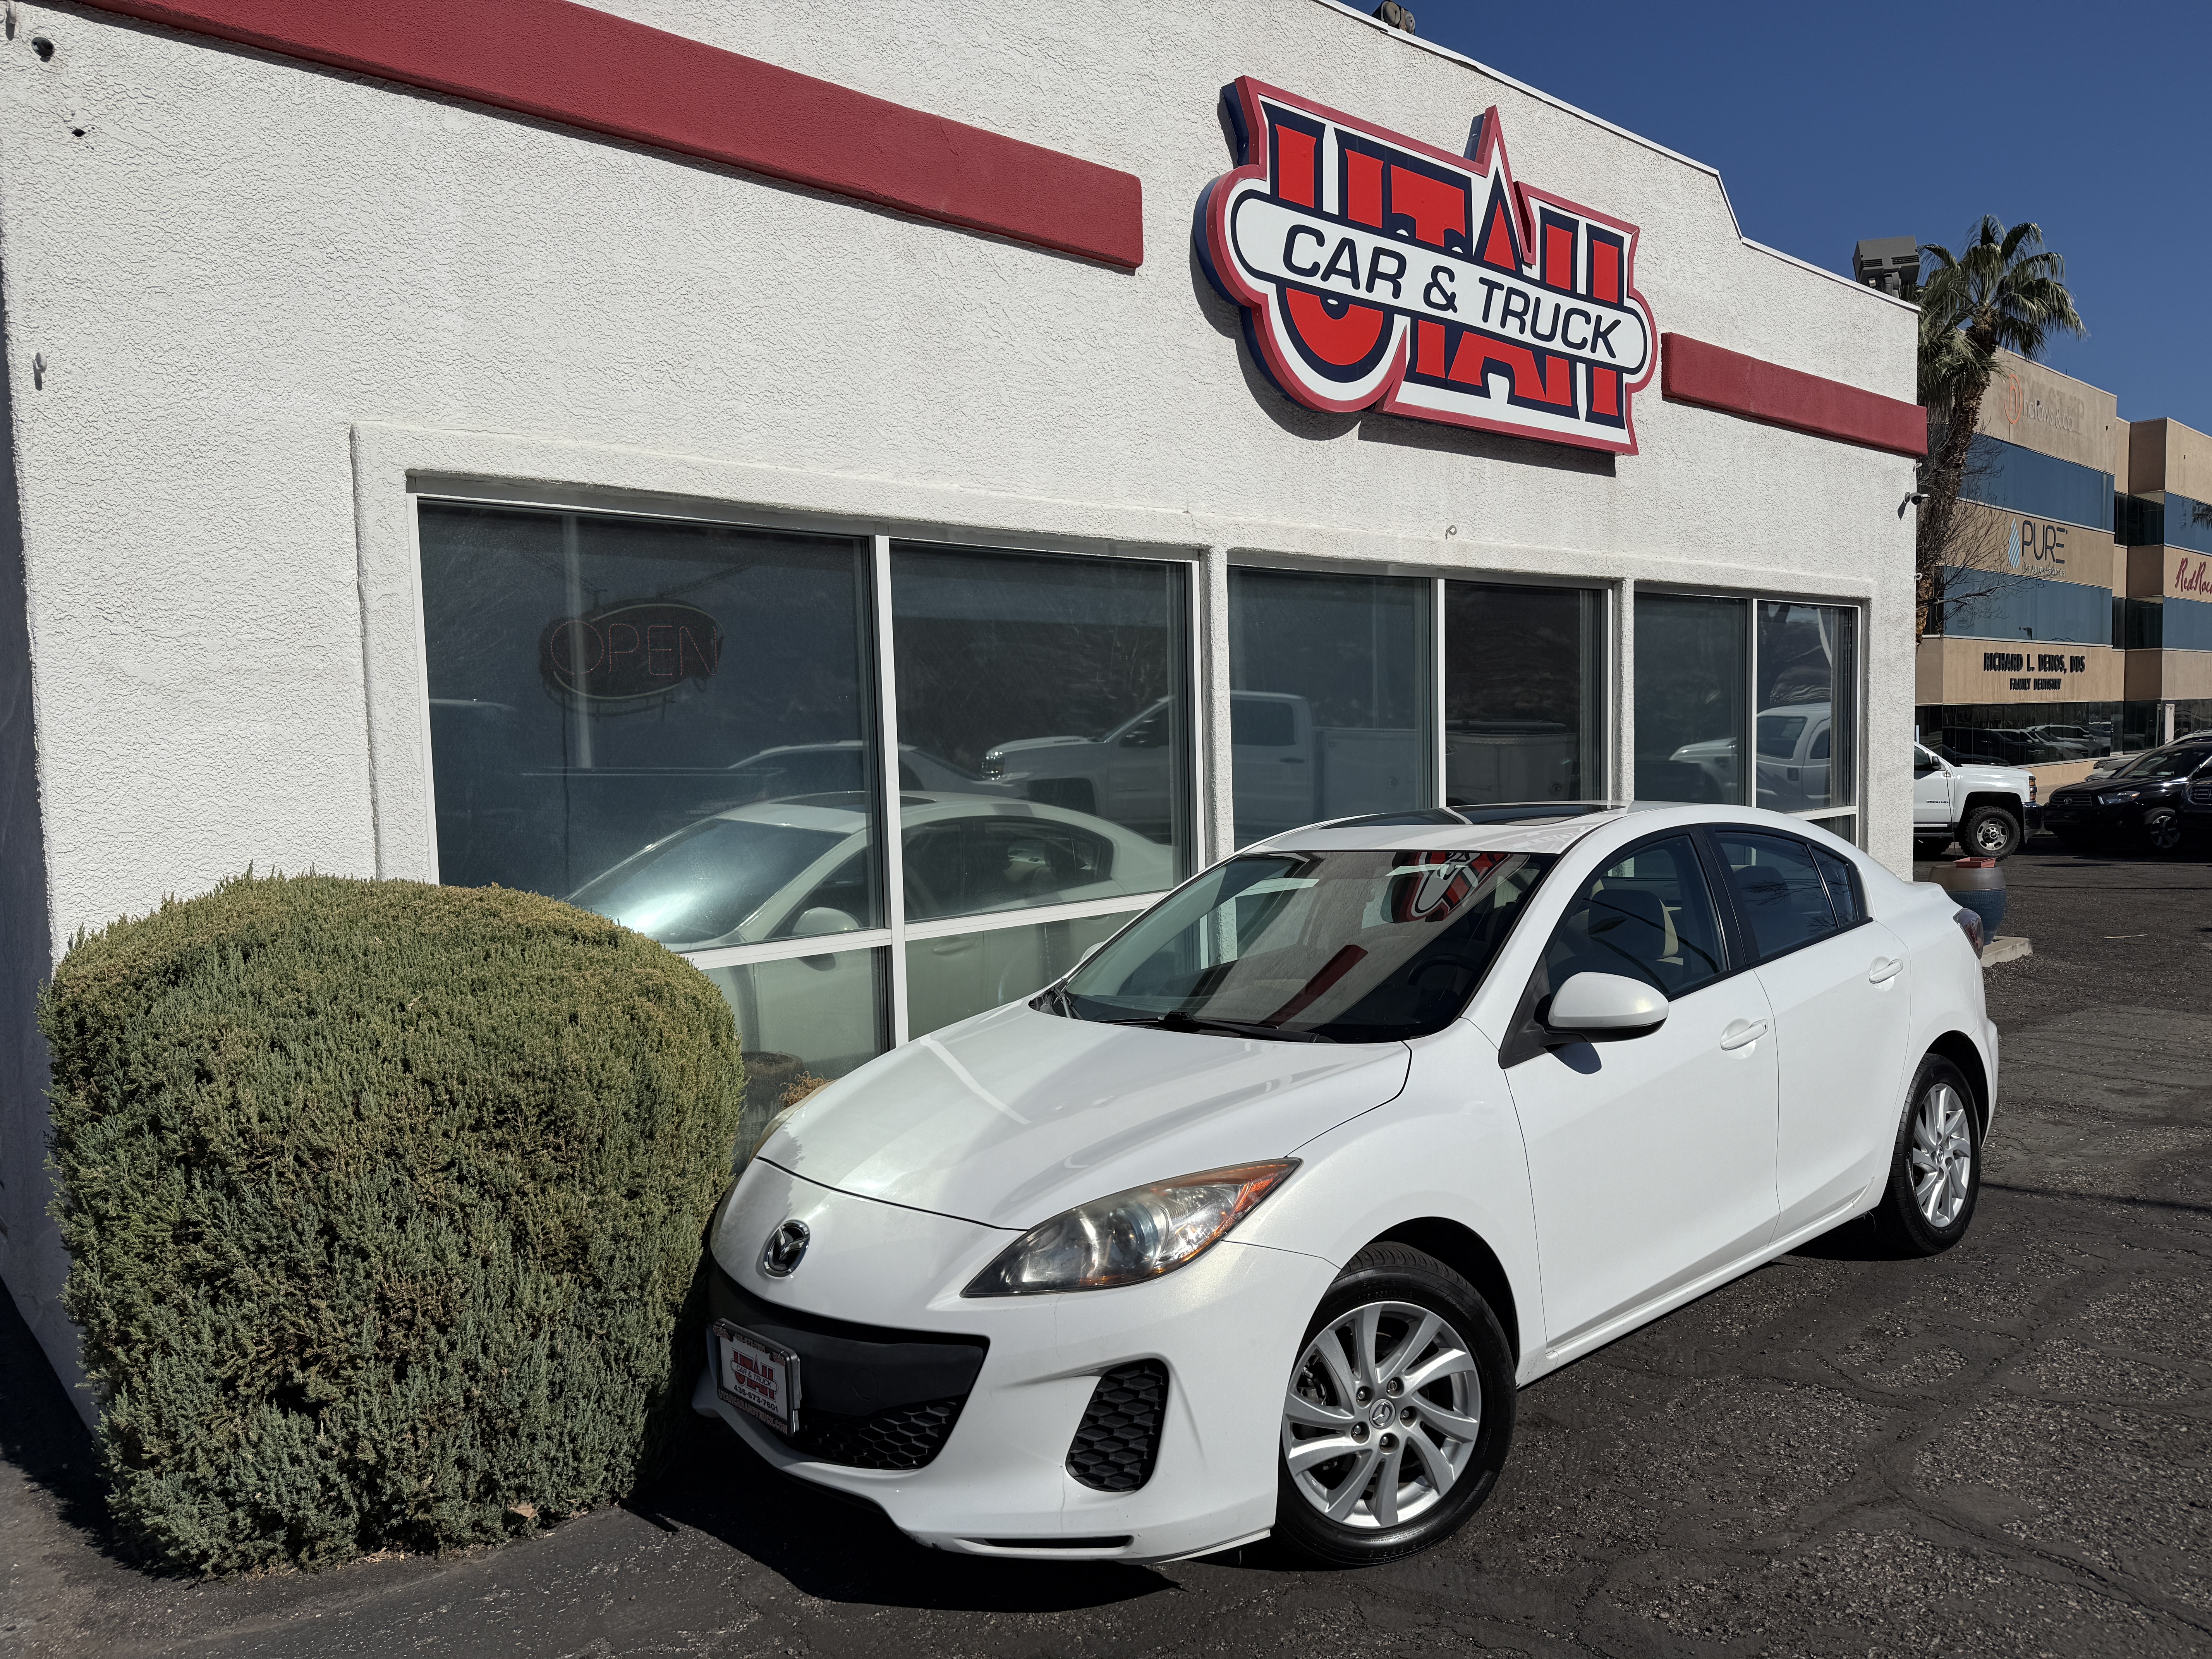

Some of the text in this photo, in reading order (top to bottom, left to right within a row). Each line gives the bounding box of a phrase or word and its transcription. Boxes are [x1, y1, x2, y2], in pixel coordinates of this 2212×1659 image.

[1261, 100, 1626, 430] UTAH
[1283, 224, 1622, 359] CAR & TRUCK
[2023, 395, 2054, 425] hallows
[2055, 409, 2061, 429] &
[2063, 414, 2073, 432] co
[2022, 520, 2066, 564] PURE
[2175, 557, 2212, 595] RedRoc
[551, 621, 717, 675] OPEN
[1984, 653, 2085, 674] RICHARD L. DENOS, DDS
[2010, 678, 2062, 690] FAMILY DENTISTRY
[732, 1348, 776, 1402] UTAH
[737, 1365, 747, 1375] CAR
[754, 1374, 771, 1387] TRUCK
[734, 1384, 778, 1412] 435-673-7601
